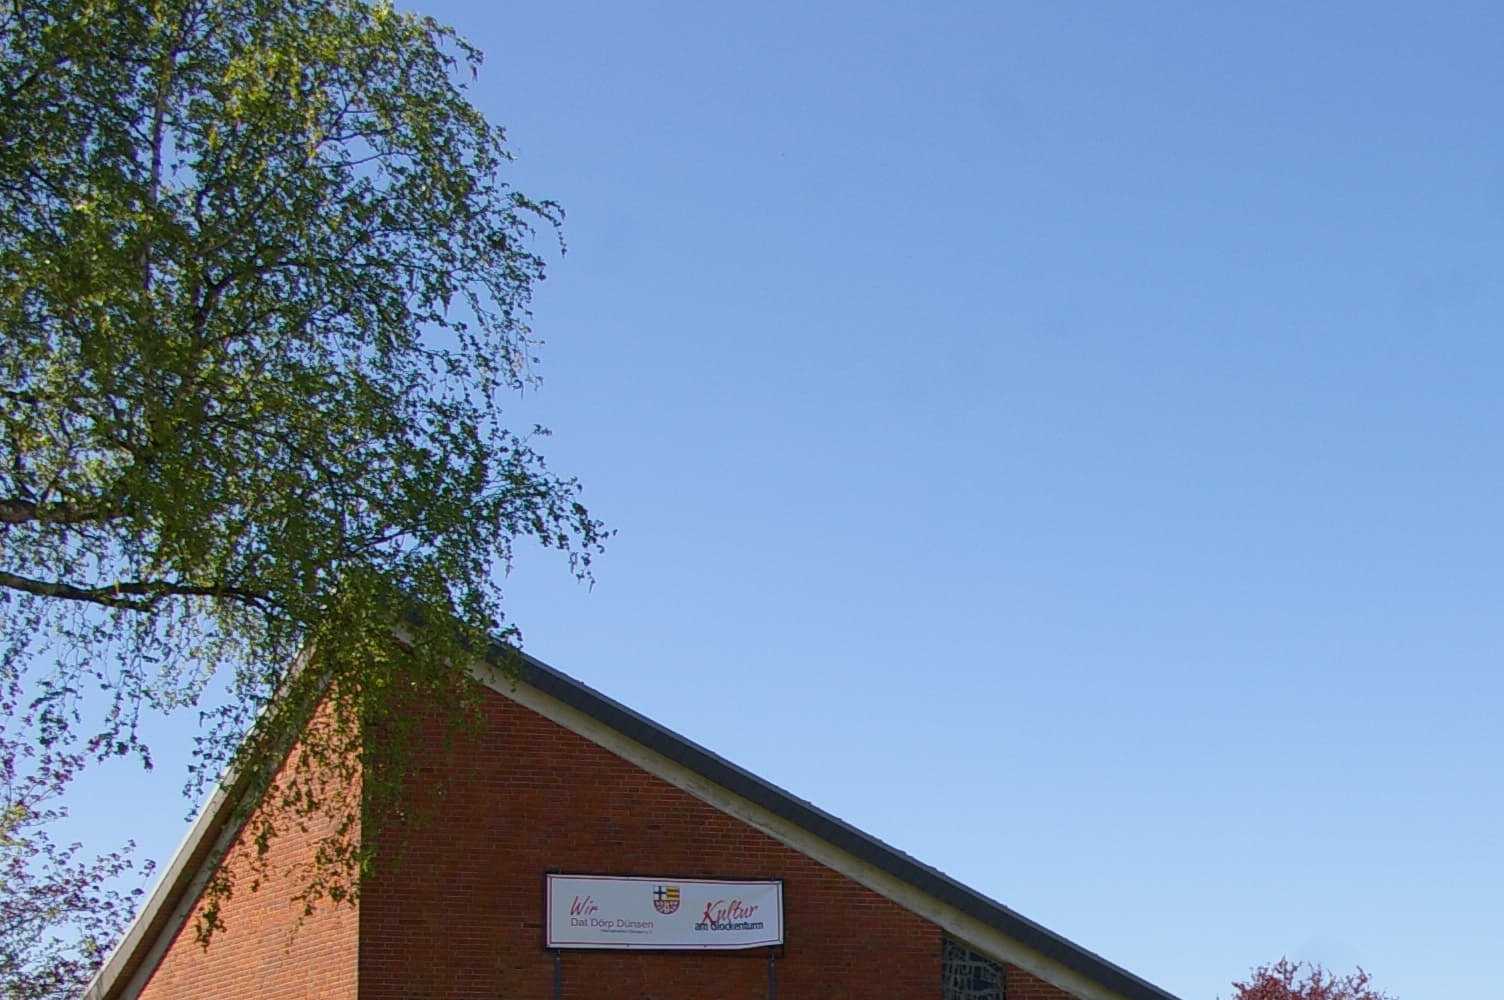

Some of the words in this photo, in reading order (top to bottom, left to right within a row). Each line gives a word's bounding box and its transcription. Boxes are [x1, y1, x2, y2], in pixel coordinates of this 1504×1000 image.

[570, 896, 598, 916] Wir
[702, 899, 758, 924] Kultur
[571, 918, 588, 927] Dat
[591, 918, 614, 928] Dörp
[617, 919, 654, 928] Dünsen
[694, 922, 708, 931] am
